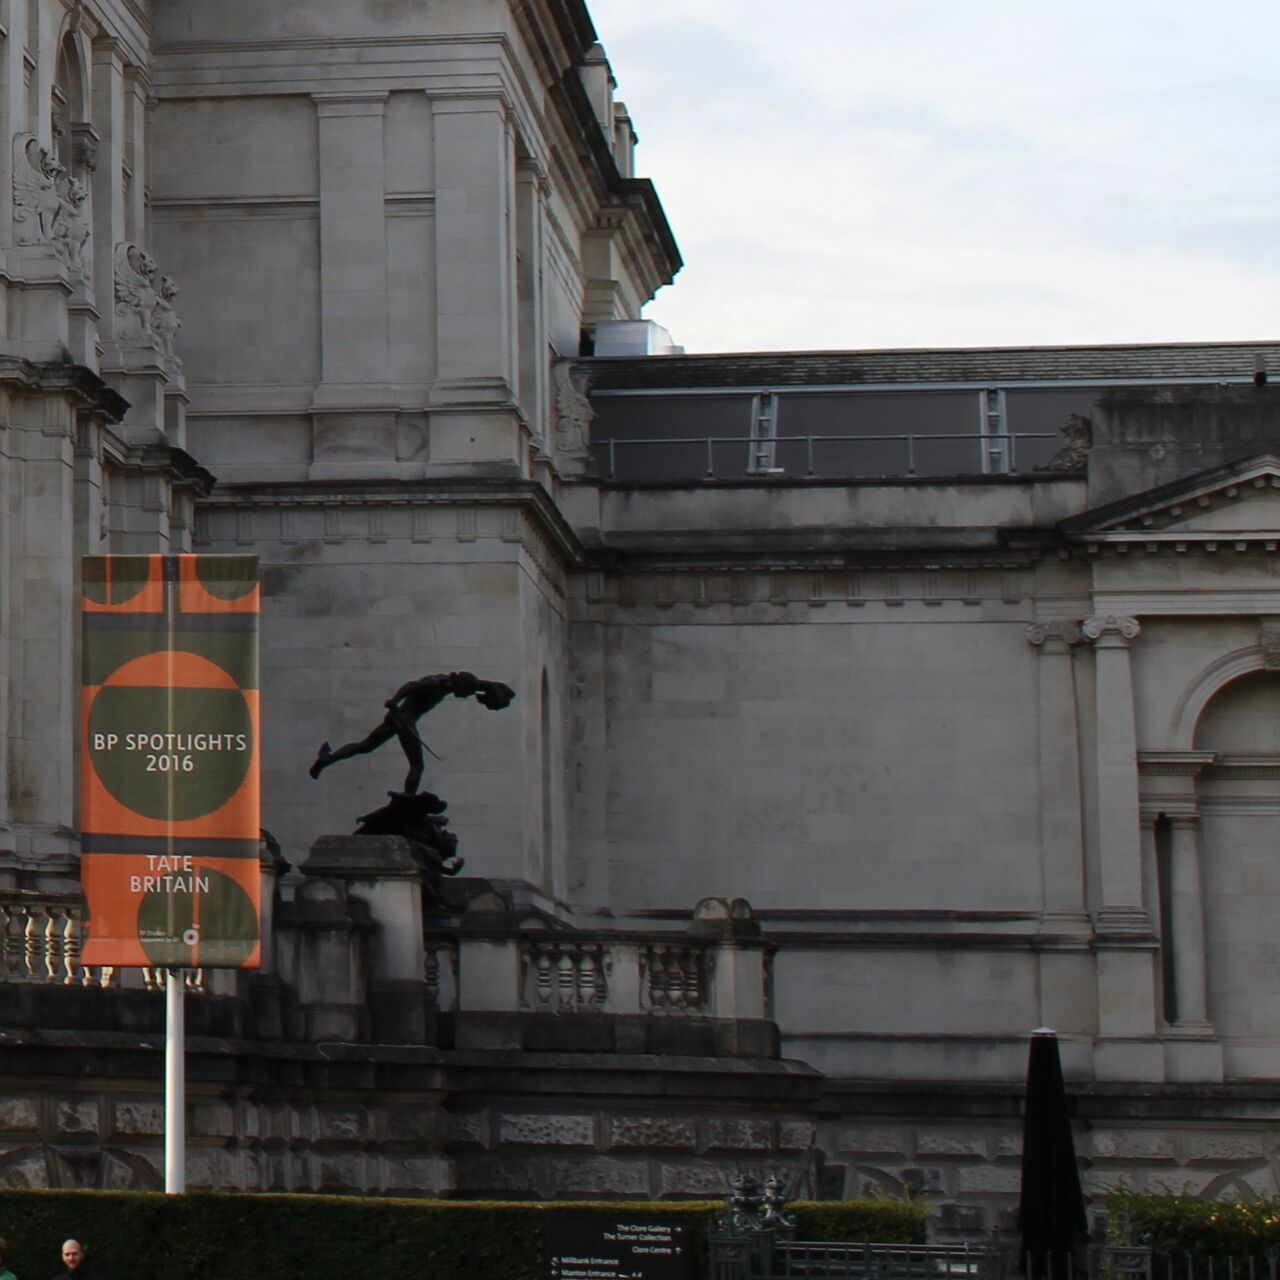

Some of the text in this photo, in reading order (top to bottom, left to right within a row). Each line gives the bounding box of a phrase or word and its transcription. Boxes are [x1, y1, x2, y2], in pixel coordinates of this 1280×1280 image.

[93, 733, 247, 751] BP SPOTLIGHTS
[145, 754, 194, 772] 2016
[146, 854, 193, 872] TATE
[130, 875, 209, 894] BRITAIN
